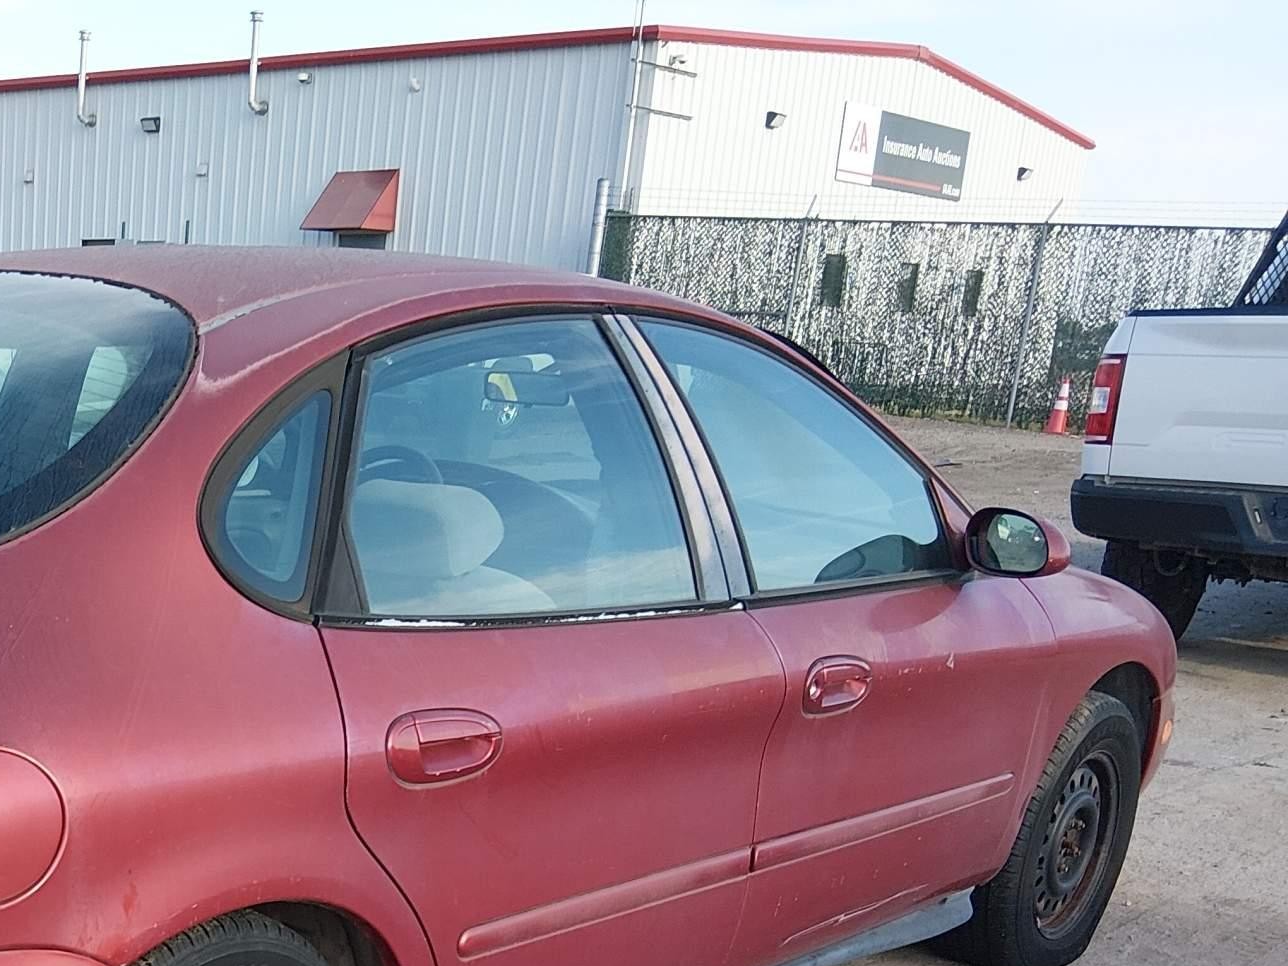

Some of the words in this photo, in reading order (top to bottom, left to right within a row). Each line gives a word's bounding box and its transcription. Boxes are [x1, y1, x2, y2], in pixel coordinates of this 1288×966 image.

[882, 135, 917, 159] Insurance
[916, 142, 934, 163] Auto
[932, 147, 962, 169] Auctions
